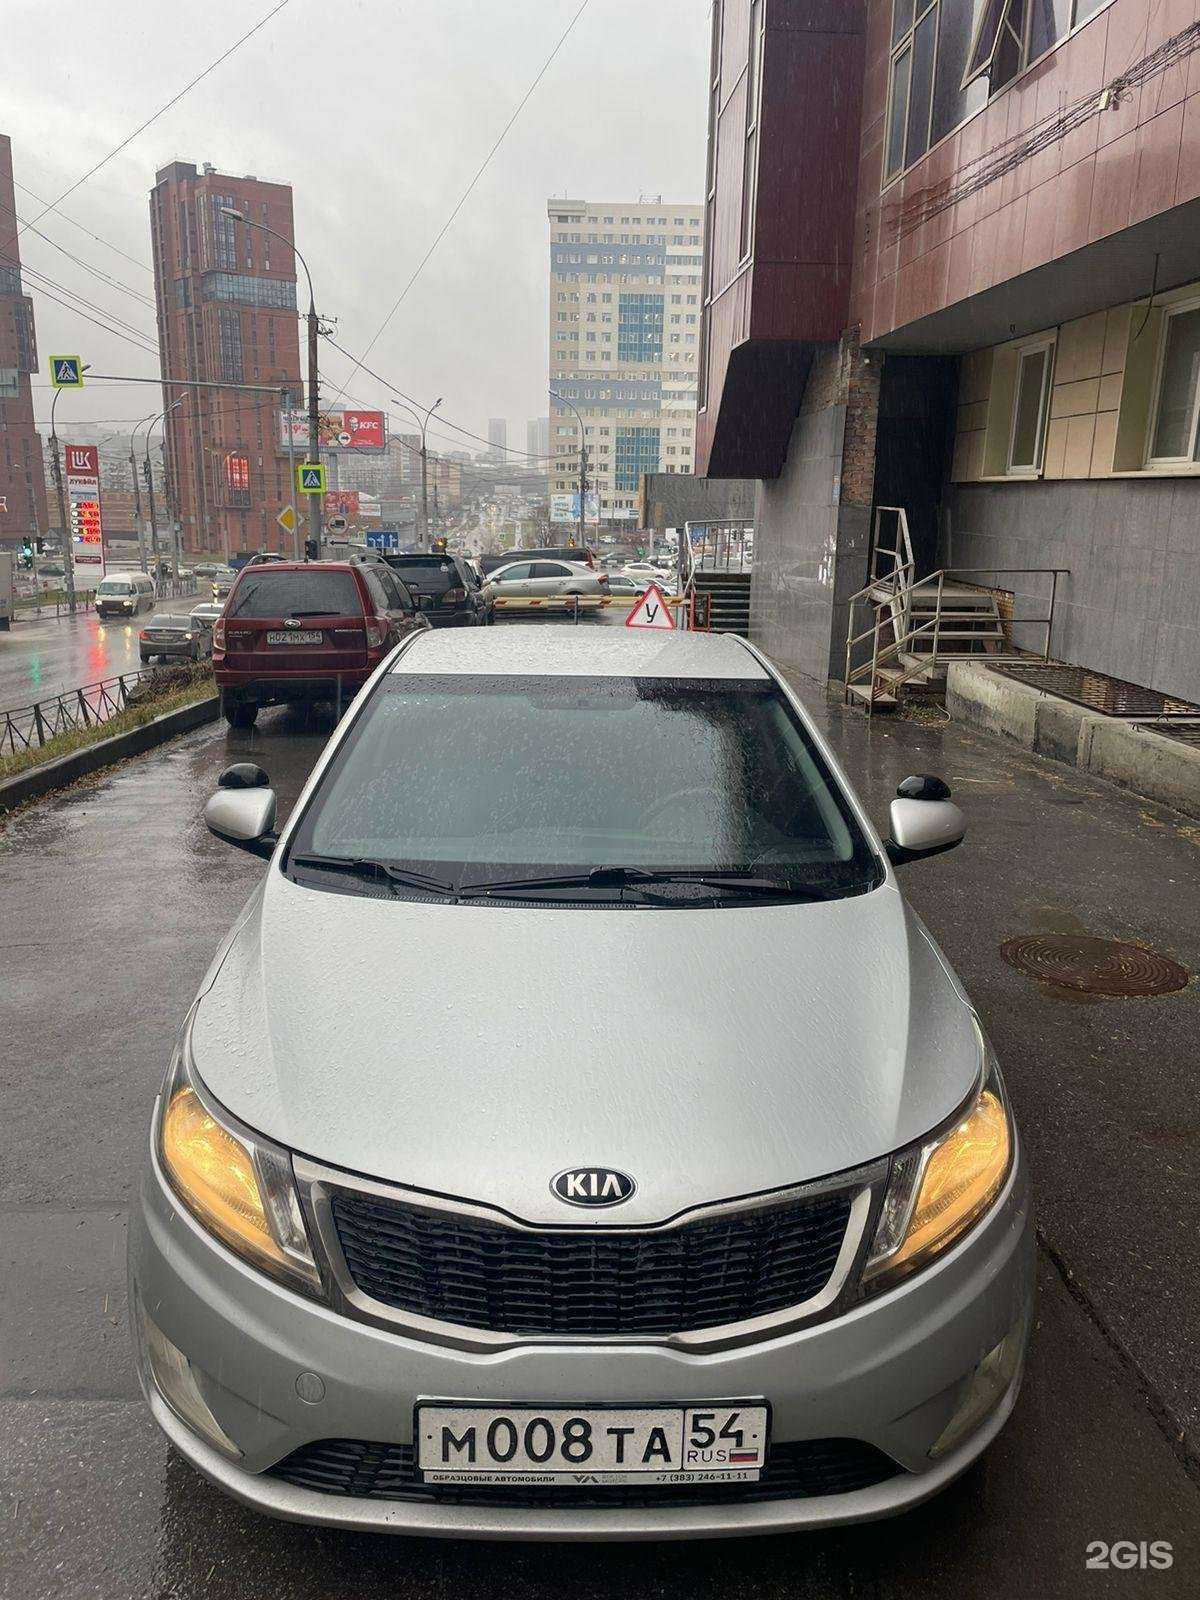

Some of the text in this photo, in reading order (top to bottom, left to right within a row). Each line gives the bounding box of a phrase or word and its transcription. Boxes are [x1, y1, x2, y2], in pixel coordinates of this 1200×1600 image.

[359, 421, 379, 430] KFC
[645, 603, 659, 623] У
[566, 1173, 623, 1197] KIA
[689, 1412, 745, 1449] 54
[686, 1449, 727, 1463] RUS
[432, 1474, 556, 1483] ОБРАЗЦОВЫЕ АВТОМОБИЛИ
[656, 1472, 748, 1482] +7 (383) 246-11-11
